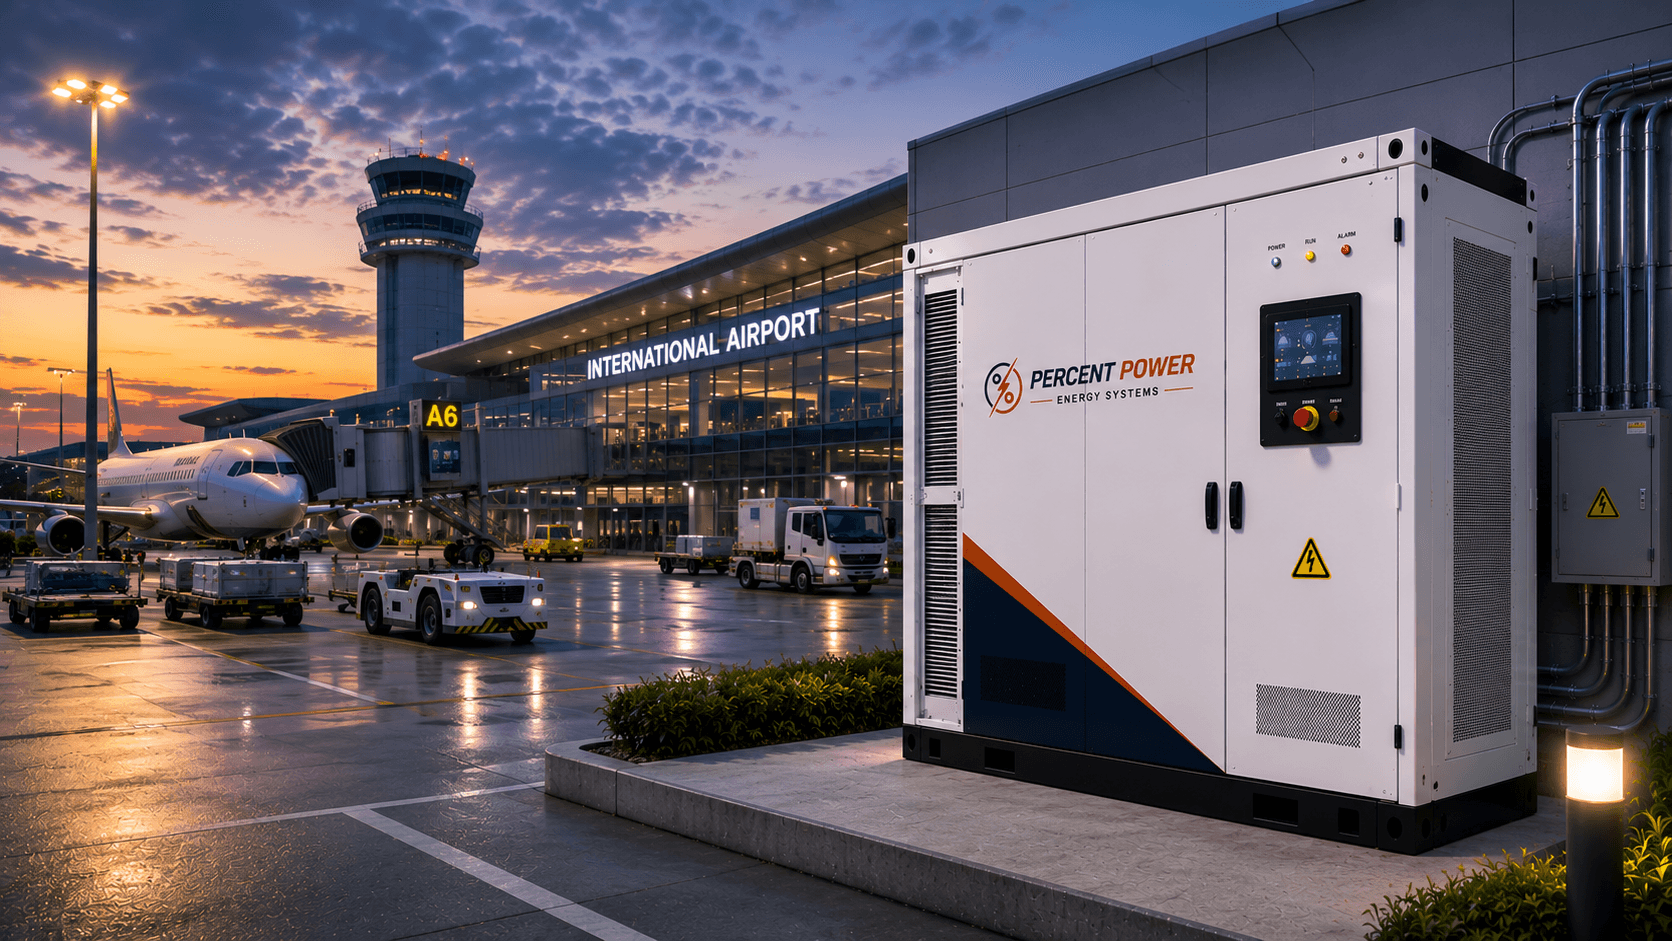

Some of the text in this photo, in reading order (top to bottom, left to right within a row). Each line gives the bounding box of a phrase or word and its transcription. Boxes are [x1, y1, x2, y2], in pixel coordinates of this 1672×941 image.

[1337, 231, 1356, 239] ALARM
[1267, 243, 1285, 251] POWER
[587, 307, 820, 380] INTERNATIONAL AIRPORT
[1030, 353, 1195, 389] PERCENT POWER
[1057, 386, 1159, 404] ENERGY SYSTEMS
[425, 404, 458, 427] A6
